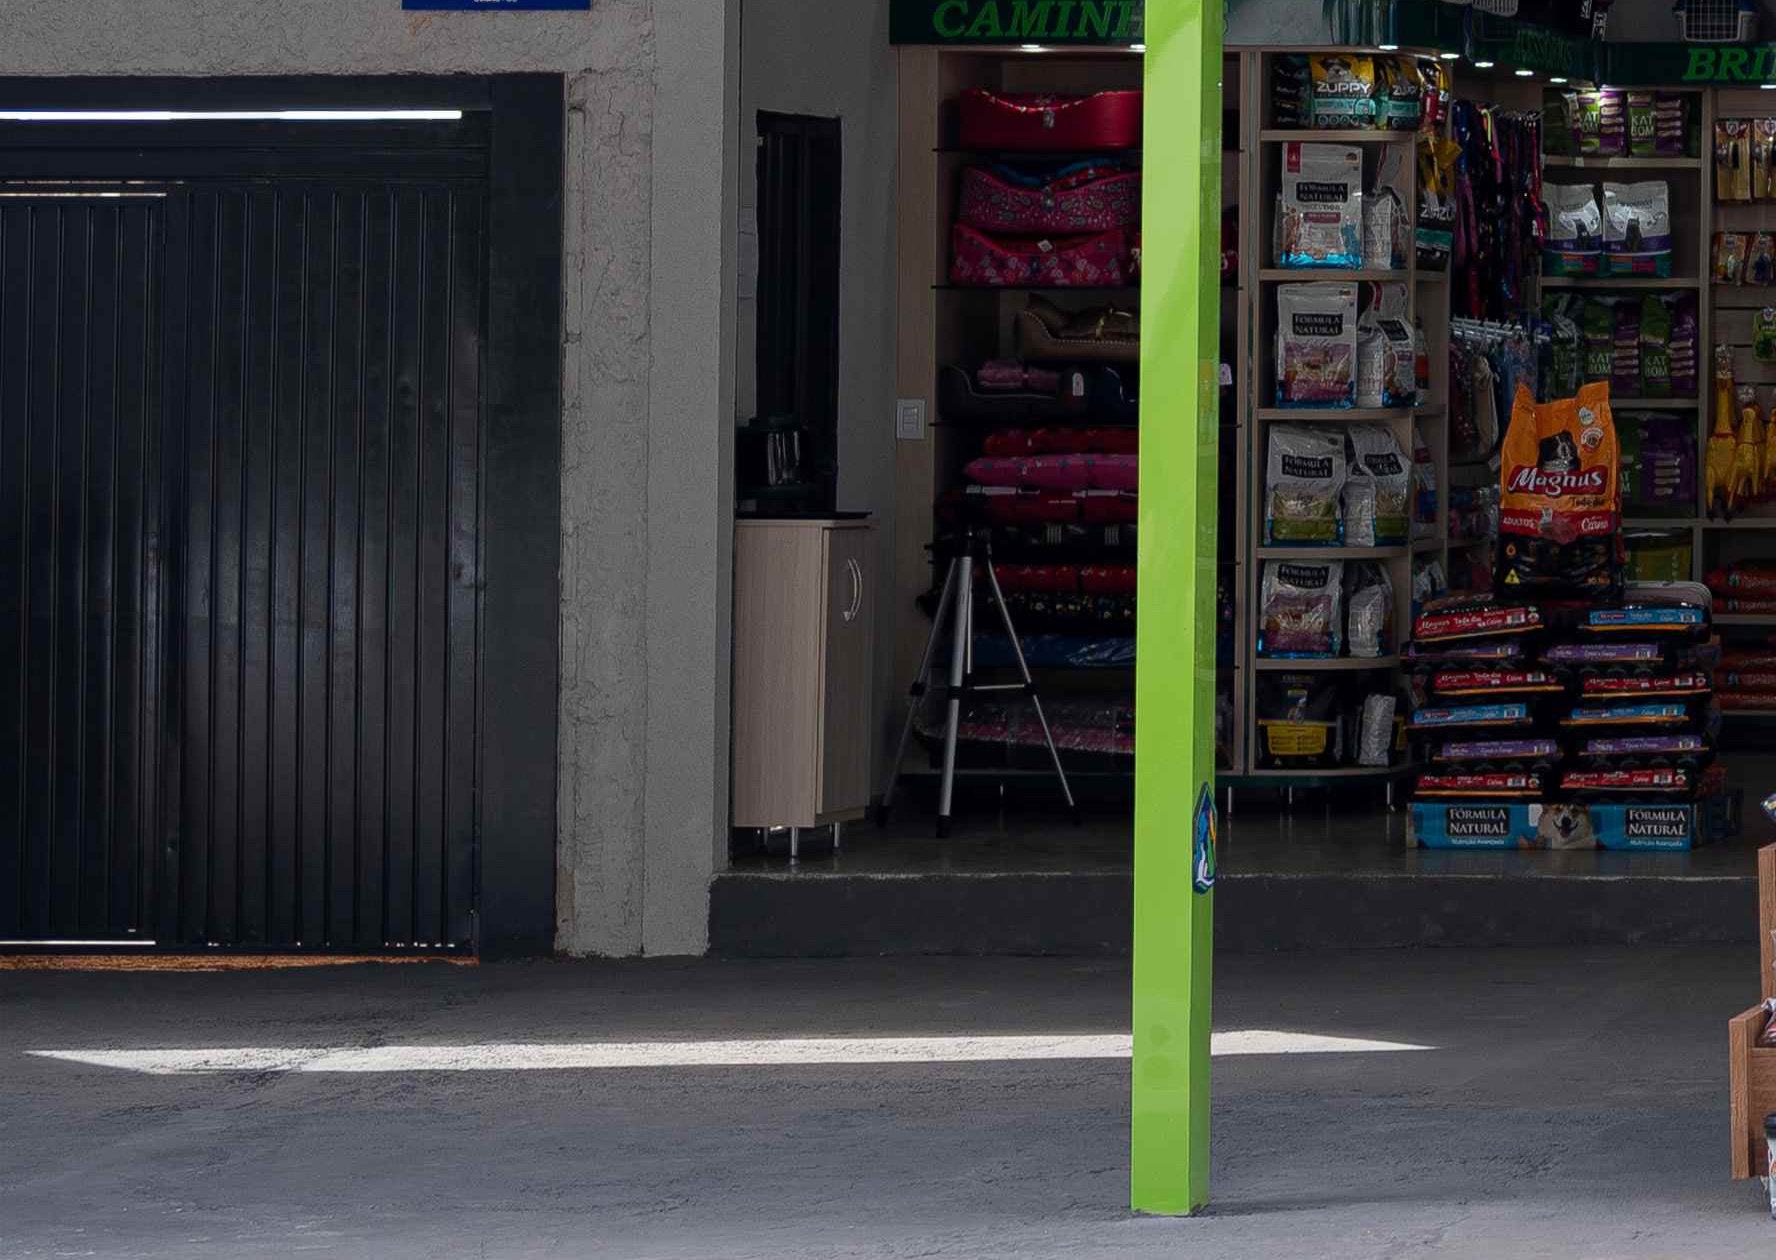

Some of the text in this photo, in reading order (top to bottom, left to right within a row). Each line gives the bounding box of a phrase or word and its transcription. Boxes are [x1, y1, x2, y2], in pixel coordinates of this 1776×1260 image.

[1316, 82, 1371, 94] ZUPPY
[1508, 467, 1603, 495] Magnus
[1449, 821, 1508, 835] NATURAL
[1628, 823, 1688, 836] NATURAL
